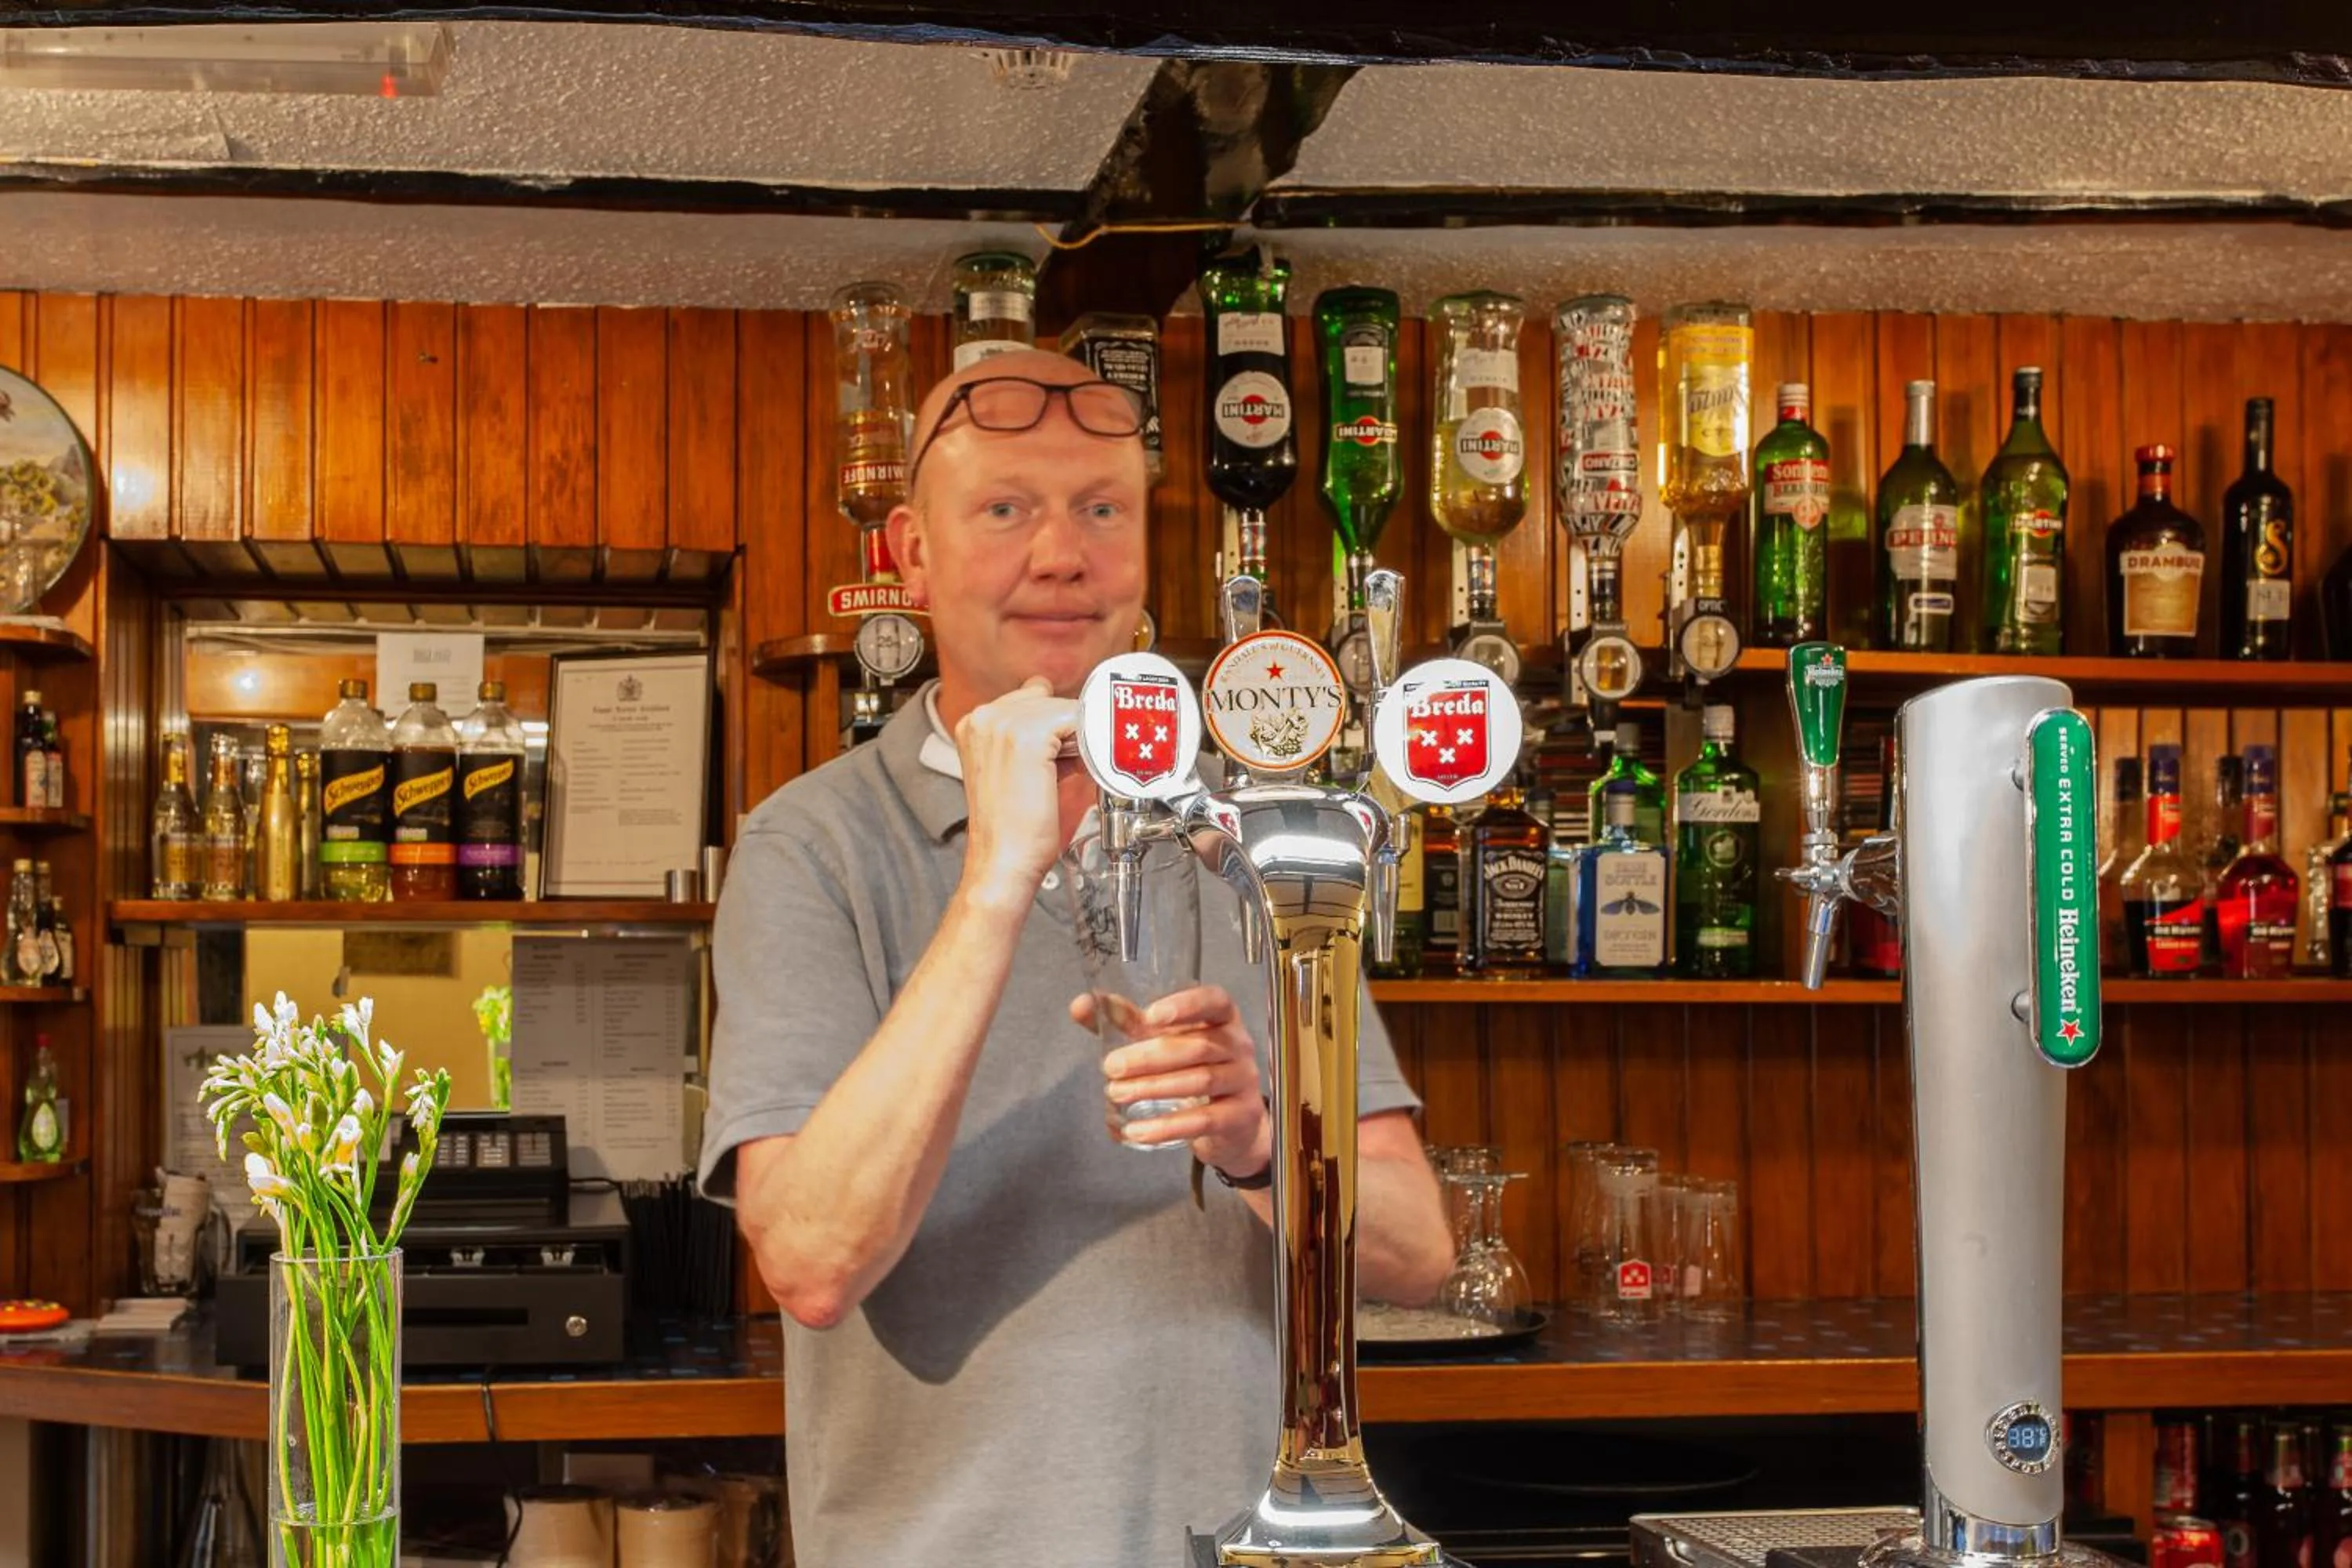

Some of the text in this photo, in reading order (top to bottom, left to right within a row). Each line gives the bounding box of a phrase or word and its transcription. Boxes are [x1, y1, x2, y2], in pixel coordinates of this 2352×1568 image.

[1224, 404, 1283, 416] MARTINI
[1461, 438, 1519, 452] MARTINI
[843, 465, 906, 484] MIRNOFF
[1114, 686, 1176, 710] Breda
[1210, 686, 1341, 711] MONTY'S
[1410, 693, 1484, 717] Breda
[394, 772, 452, 809] Schweppes
[2057, 727, 2080, 1013] SERVED EXTRA COLD Heineken
